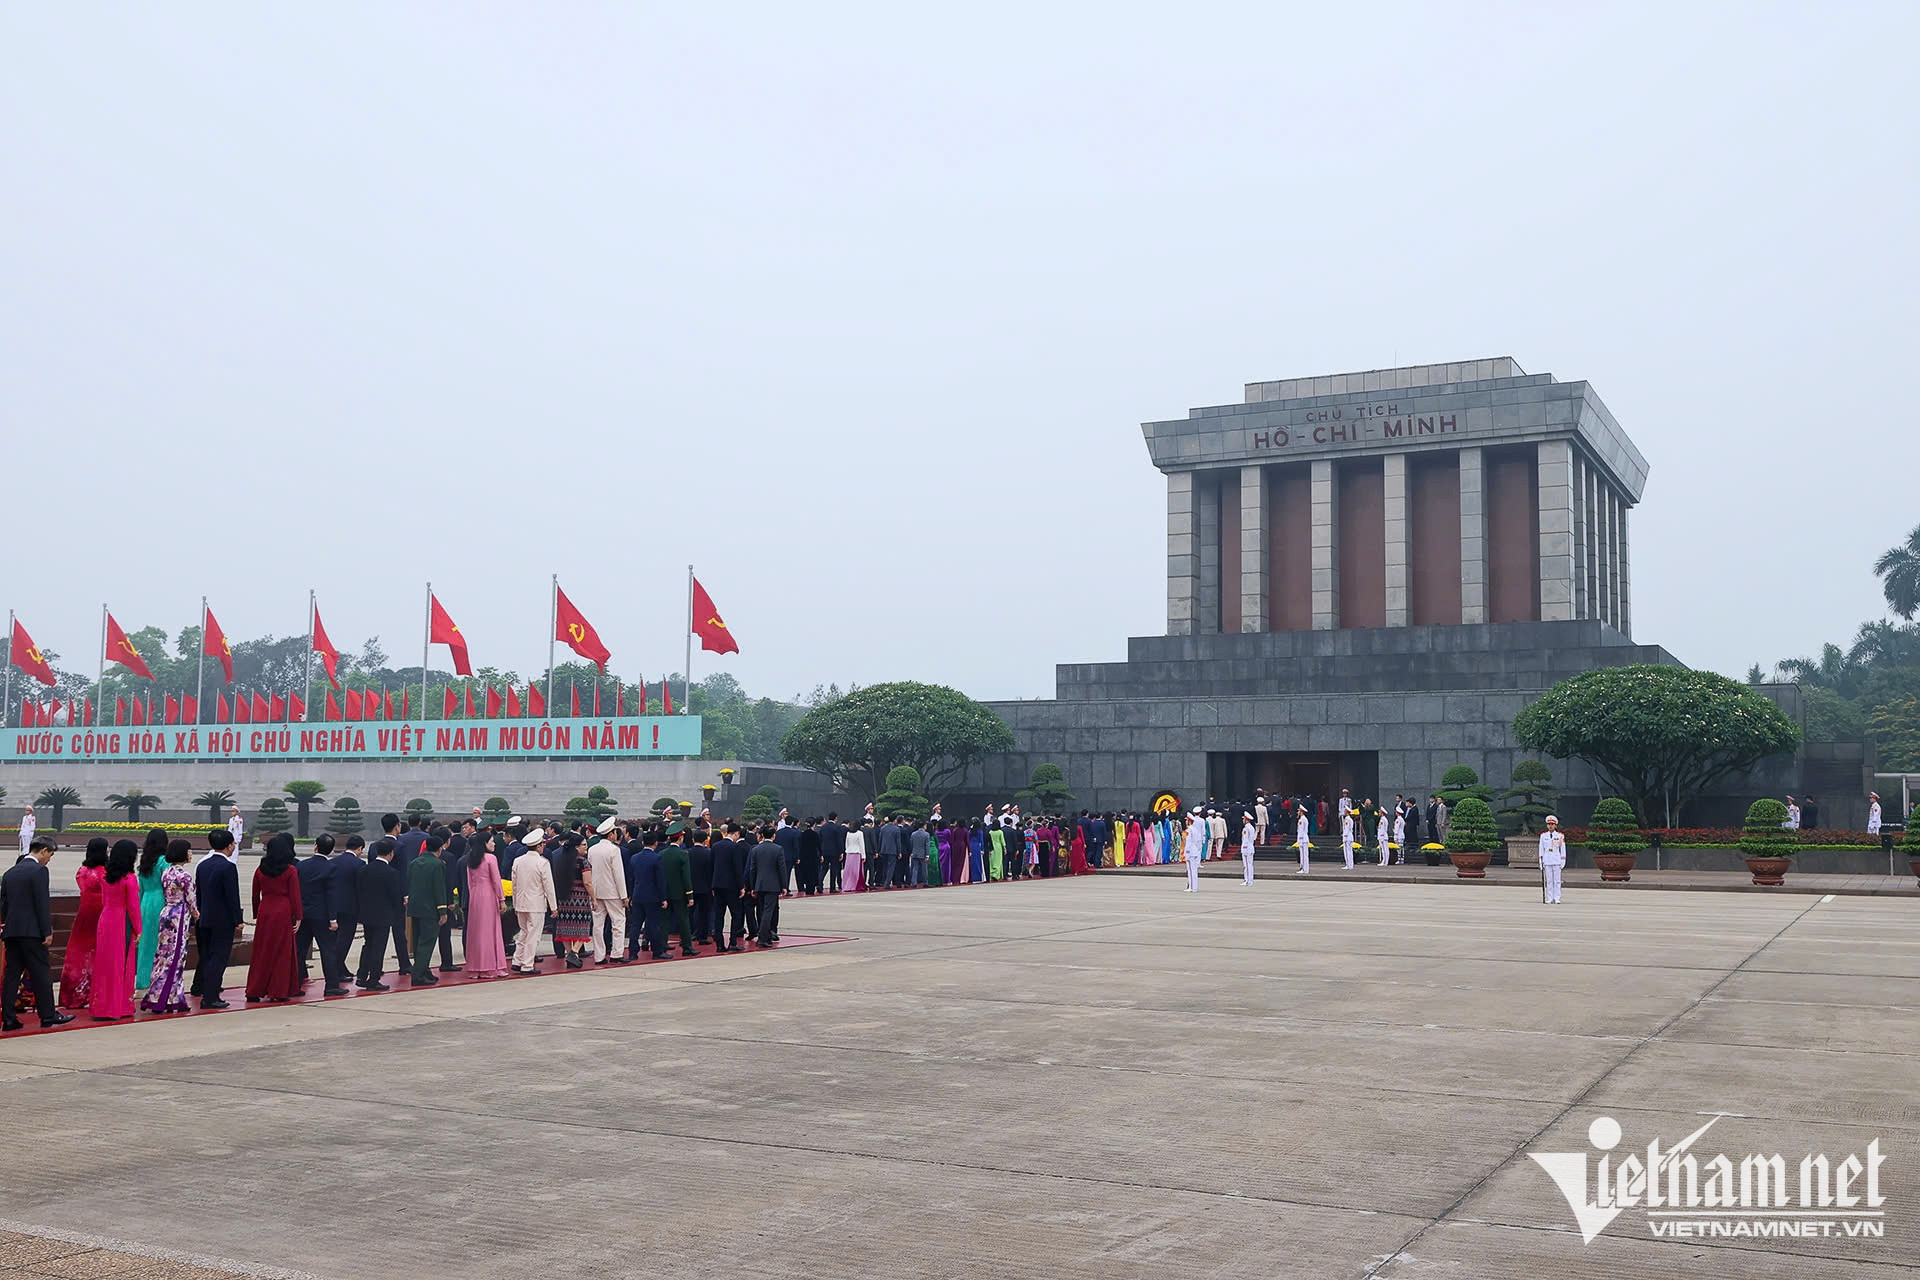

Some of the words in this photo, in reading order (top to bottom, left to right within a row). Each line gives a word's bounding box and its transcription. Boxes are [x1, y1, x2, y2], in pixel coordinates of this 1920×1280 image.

[16, 730, 64, 754] NƯỚC
[71, 728, 120, 757] CỘNG
[128, 729, 166, 754] HÒA
[174, 728, 199, 753] XÃ
[208, 727, 241, 757] HỘI
[250, 724, 291, 753] CHỦ
[300, 726, 366, 753] NGHĨA
[378, 724, 426, 755] VIỆT
[436, 727, 488, 752] NAM
[499, 722, 571, 751] MUÔN
[582, 720, 639, 750] NĂM
[652, 725, 659, 749] !
